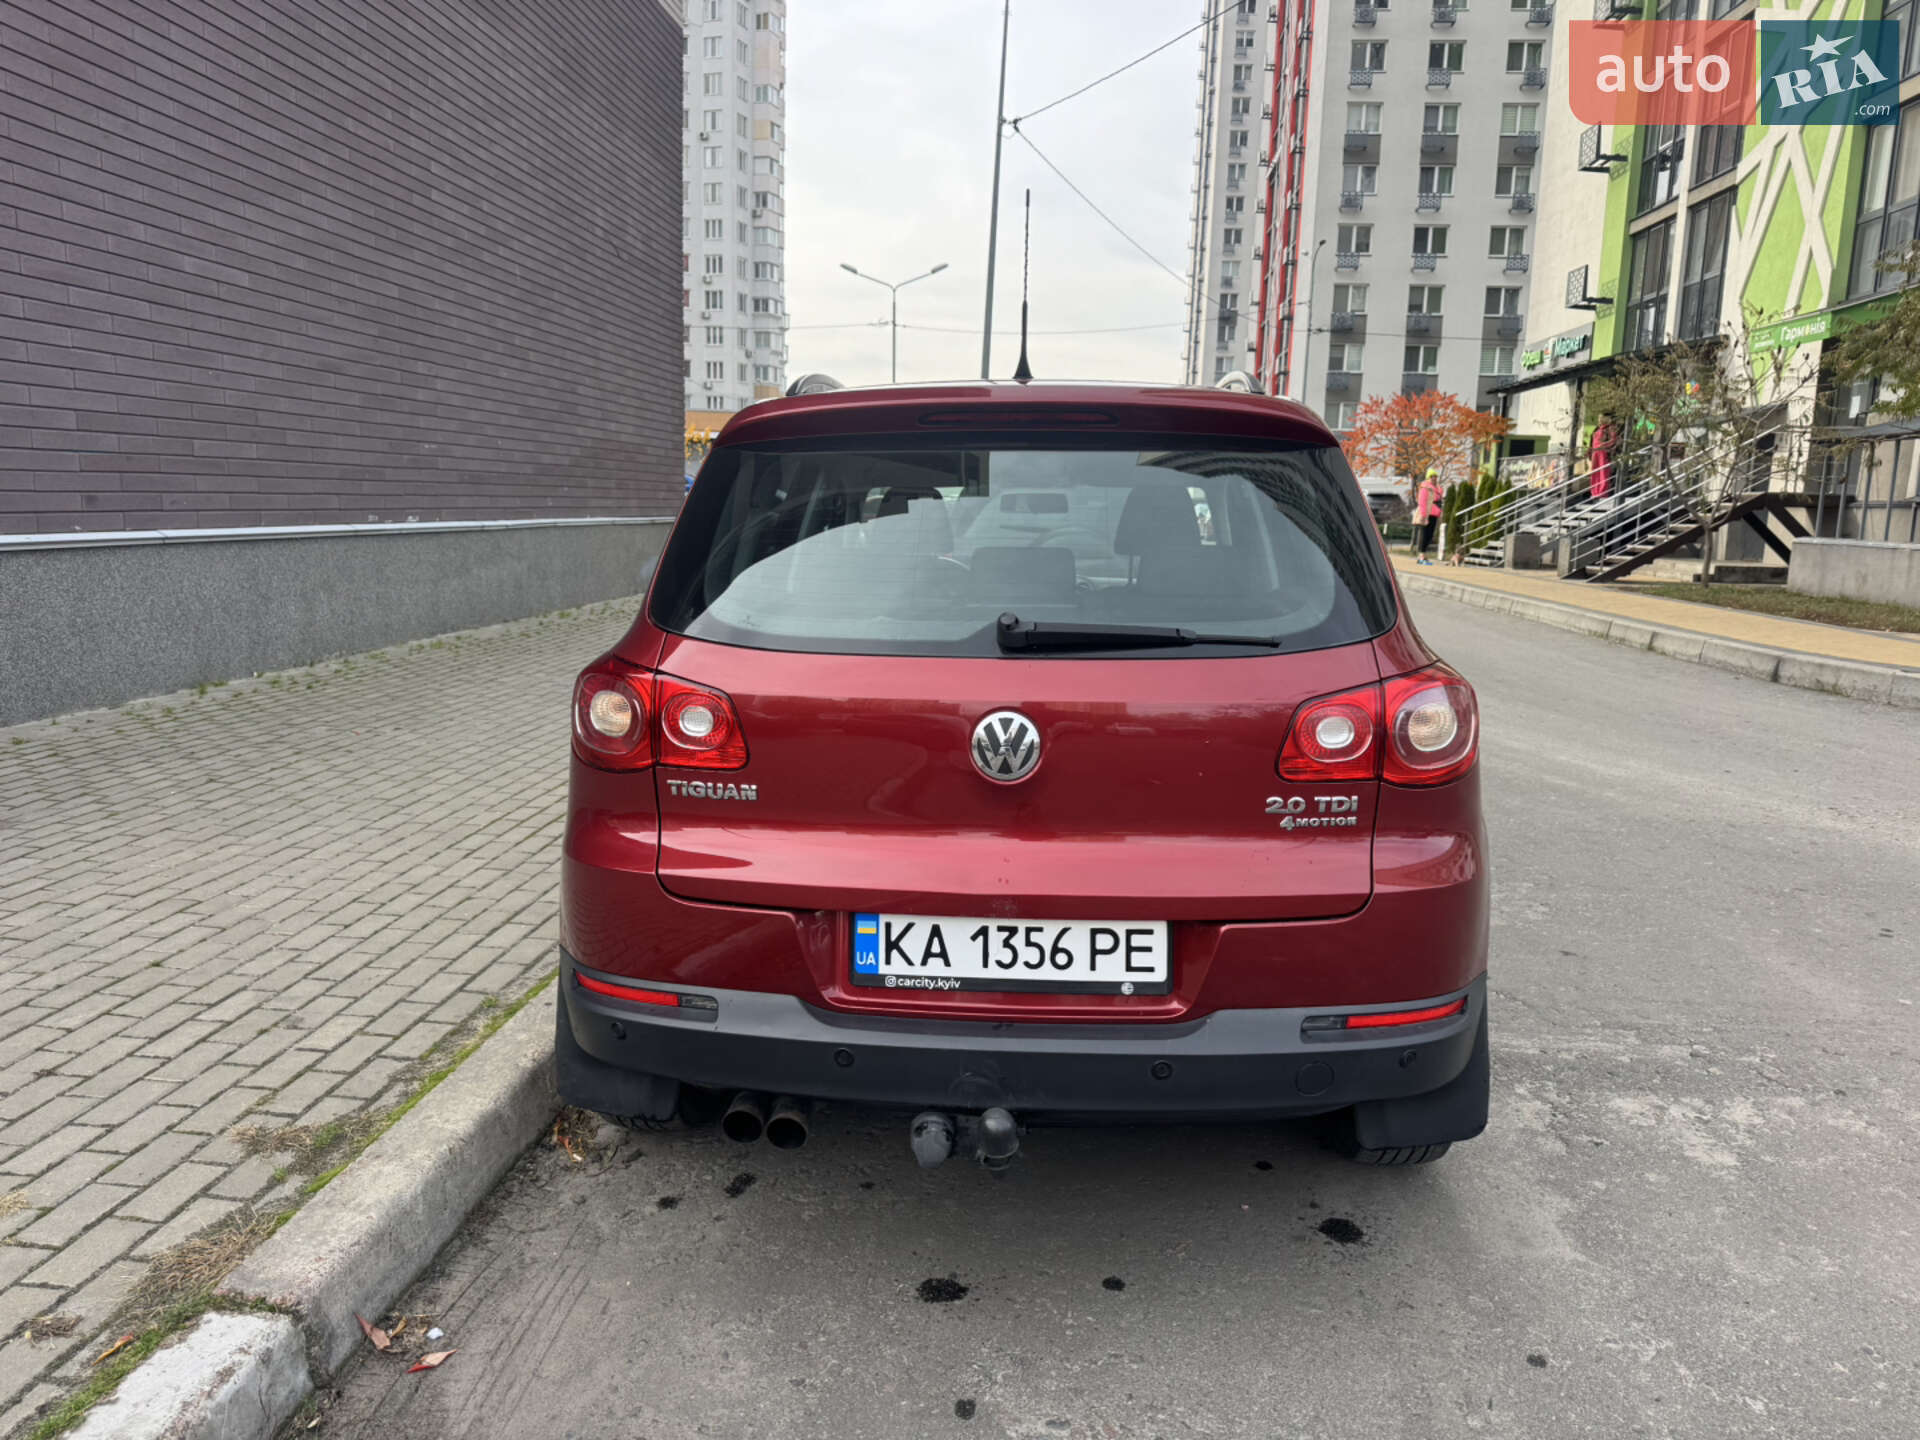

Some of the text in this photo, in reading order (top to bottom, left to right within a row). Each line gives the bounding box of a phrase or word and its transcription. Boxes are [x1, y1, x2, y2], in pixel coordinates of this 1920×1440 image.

[667, 780, 758, 801] TIGUAN
[1314, 795, 1359, 813] TDI
[1280, 815, 1357, 831] 4MOTION
[883, 921, 1155, 972] KA 1356 PE
[857, 952, 876, 965] UA
